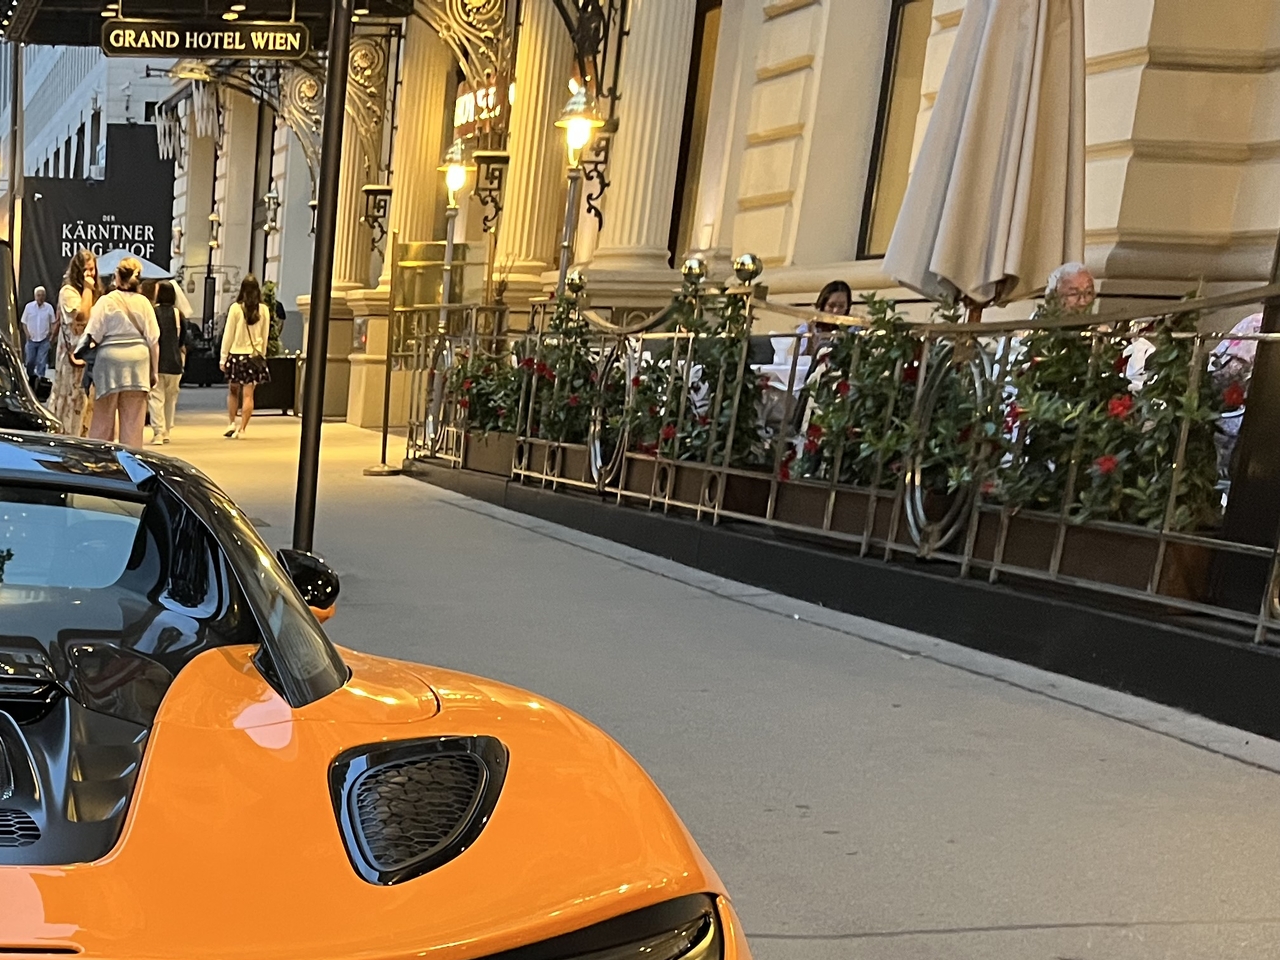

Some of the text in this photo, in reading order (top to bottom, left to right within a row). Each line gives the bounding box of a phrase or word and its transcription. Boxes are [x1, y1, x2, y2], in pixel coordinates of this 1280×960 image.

[109, 29, 301, 51] GRAND HOTEL WIEN
[102, 214, 116, 222] DER
[61, 220, 155, 241] KÄRNTNER
